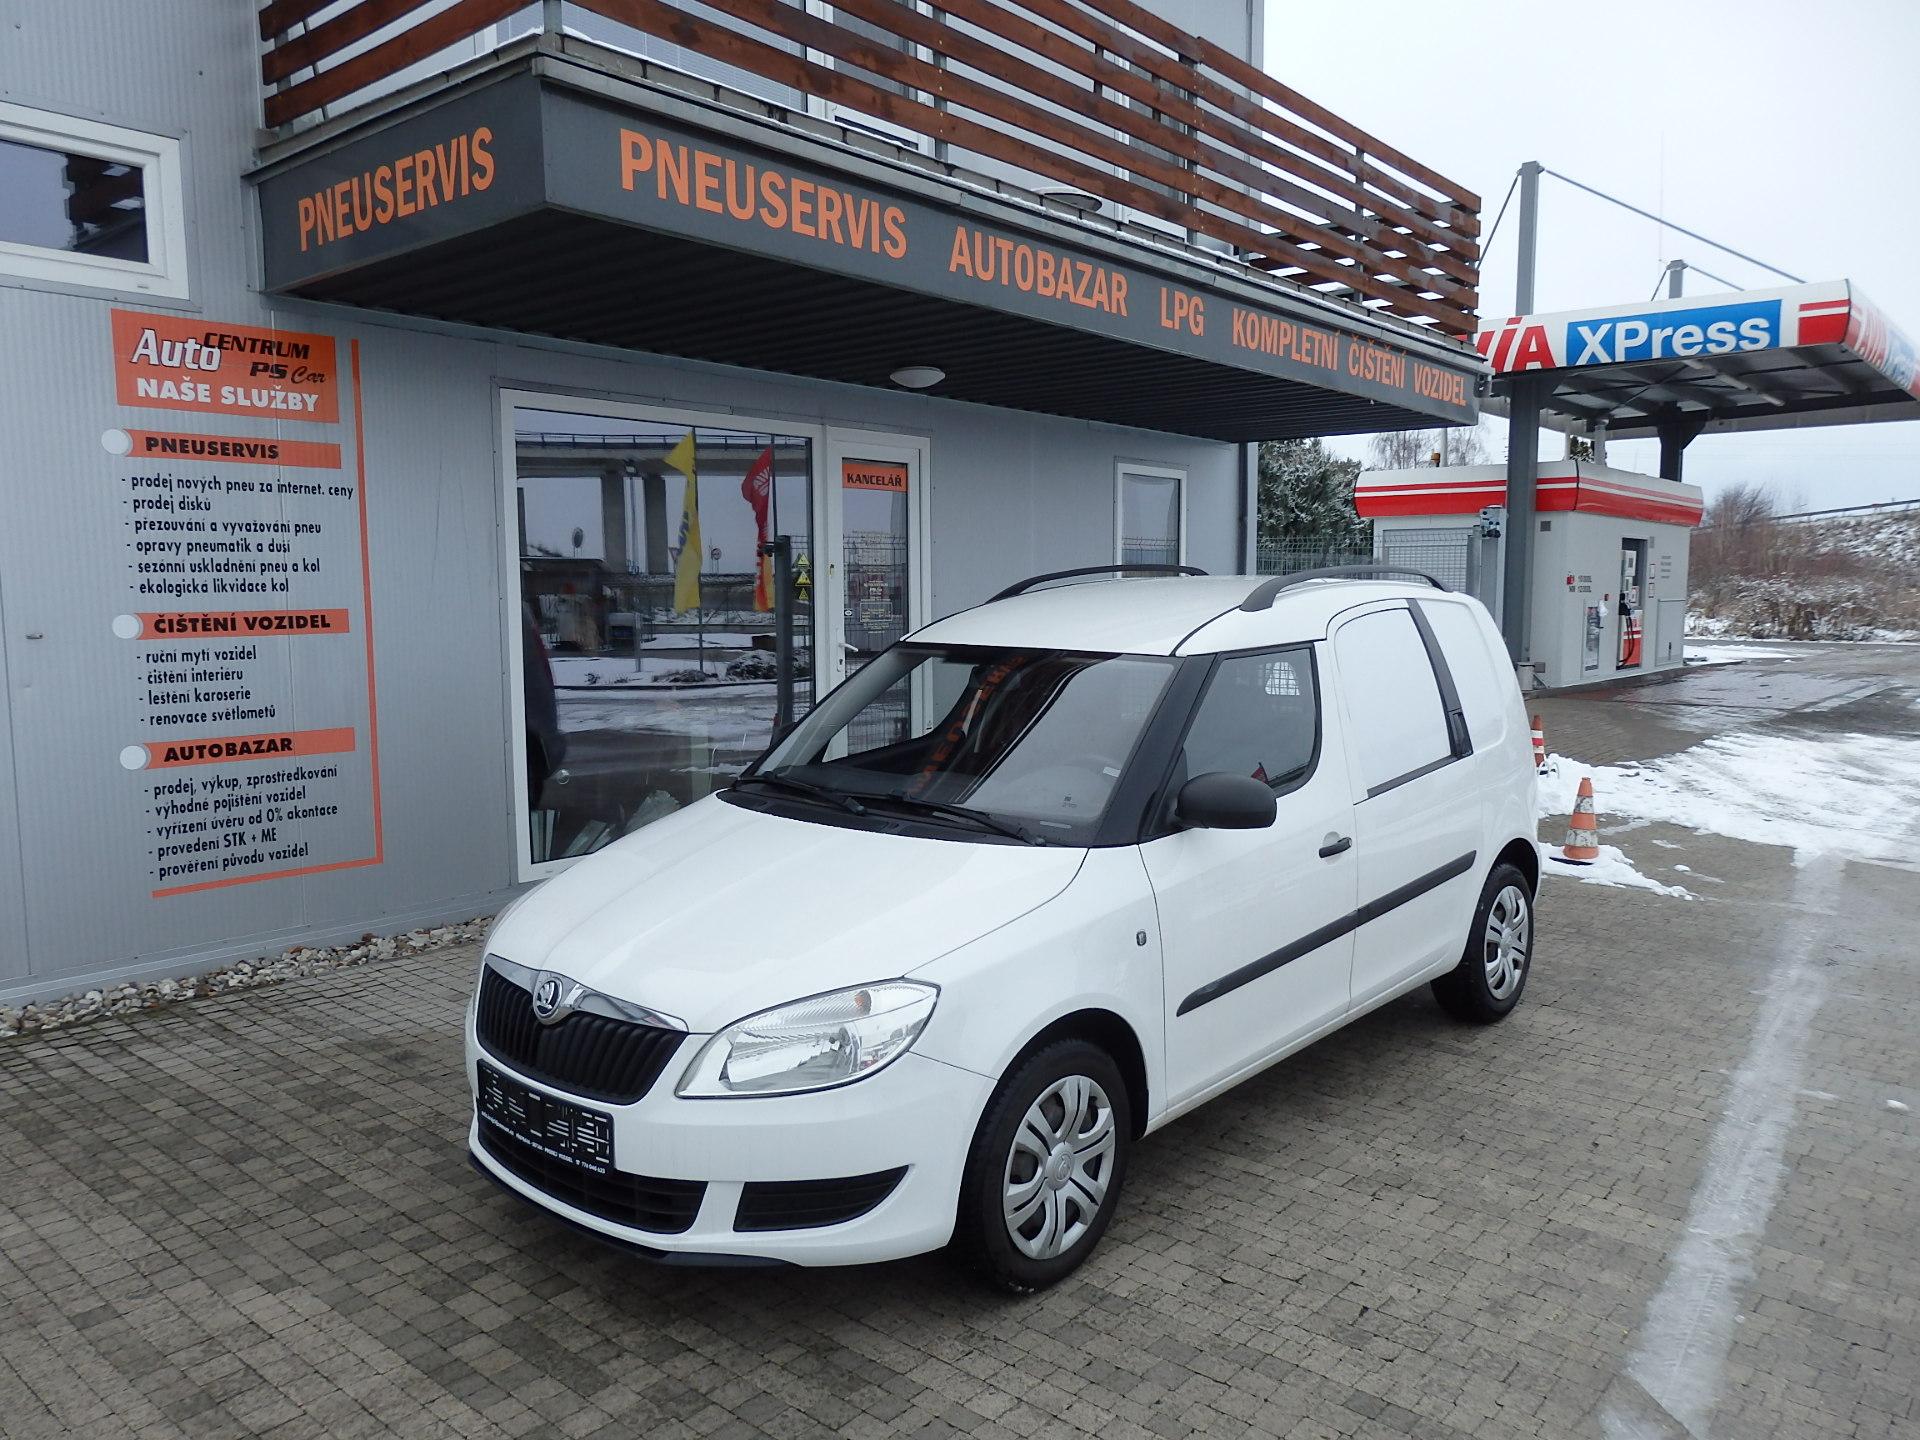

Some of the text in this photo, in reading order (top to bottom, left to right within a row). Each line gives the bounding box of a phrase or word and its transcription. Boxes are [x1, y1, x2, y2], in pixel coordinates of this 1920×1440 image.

[298, 127, 495, 252] PNEUSERVIS
[620, 128, 1467, 407] PNEUSERVIS AUTOBAZAR LPG KOMPLETNÍ ČIŠTĚNÍ VOZIDEL
[130, 328, 310, 371] Auto CENTRUM
[1576, 318, 1772, 366] XPress
[250, 362, 326, 384] PS Car
[137, 375, 319, 412] NAŠE SLUŽBY
[145, 436, 280, 459] PNEUSERVIS
[131, 473, 354, 500] prodej nových pneu za internet. ceny
[846, 472, 902, 487] KANCELÁŘ
[133, 495, 211, 513] prodej disků
[135, 517, 321, 536] přezouvání a vyvažování pneu
[136, 541, 182, 555] opravy
[187, 539, 251, 554] pneumatik
[257, 544, 263, 553] a
[138, 558, 320, 575] sezónní uskladnění pneu a kol
[139, 578, 289, 597] ekologická likvidace kol
[154, 613, 331, 633] ČIŠTĚNÍ VOZIDEL
[146, 649, 177, 663] ruční
[214, 645, 257, 660] vozidel
[148, 667, 243, 684] čištění interiéru
[149, 686, 250, 705] leštění karoserie
[150, 706, 276, 725] renovace světlometů
[164, 738, 293, 762] AUTOBAZAR
[154, 765, 337, 799] prodej, výkup, zprostředkování
[155, 786, 306, 819] výhodné pojištění vozidel
[211, 812, 245, 830] úvěru
[249, 810, 263, 825] od
[266, 808, 283, 824] 0%
[287, 804, 338, 820] akontace
[158, 837, 220, 861] provedení
[224, 832, 246, 847] STK
[261, 828, 276, 842] ME
[159, 843, 309, 881] prověření původu vozidel
